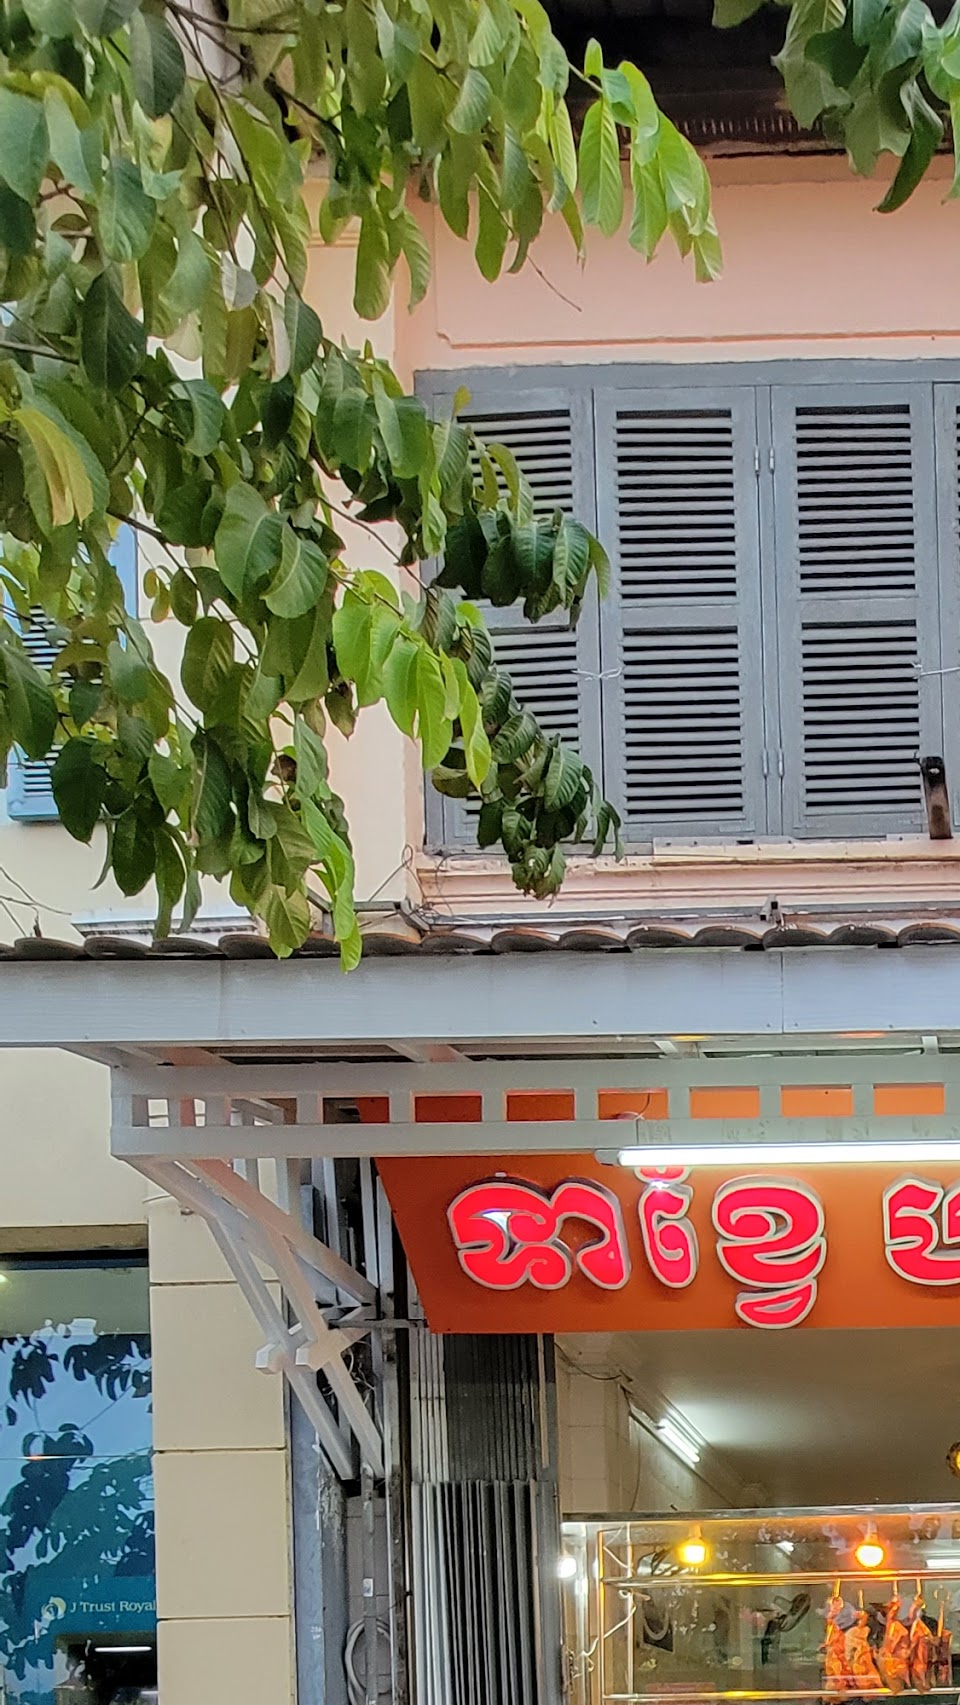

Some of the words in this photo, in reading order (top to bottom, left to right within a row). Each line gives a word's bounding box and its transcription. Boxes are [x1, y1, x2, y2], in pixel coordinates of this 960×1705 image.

[70, 1602, 77, 1613] J
[80, 1601, 116, 1612] Trust
[119, 1600, 157, 1614] Royal
